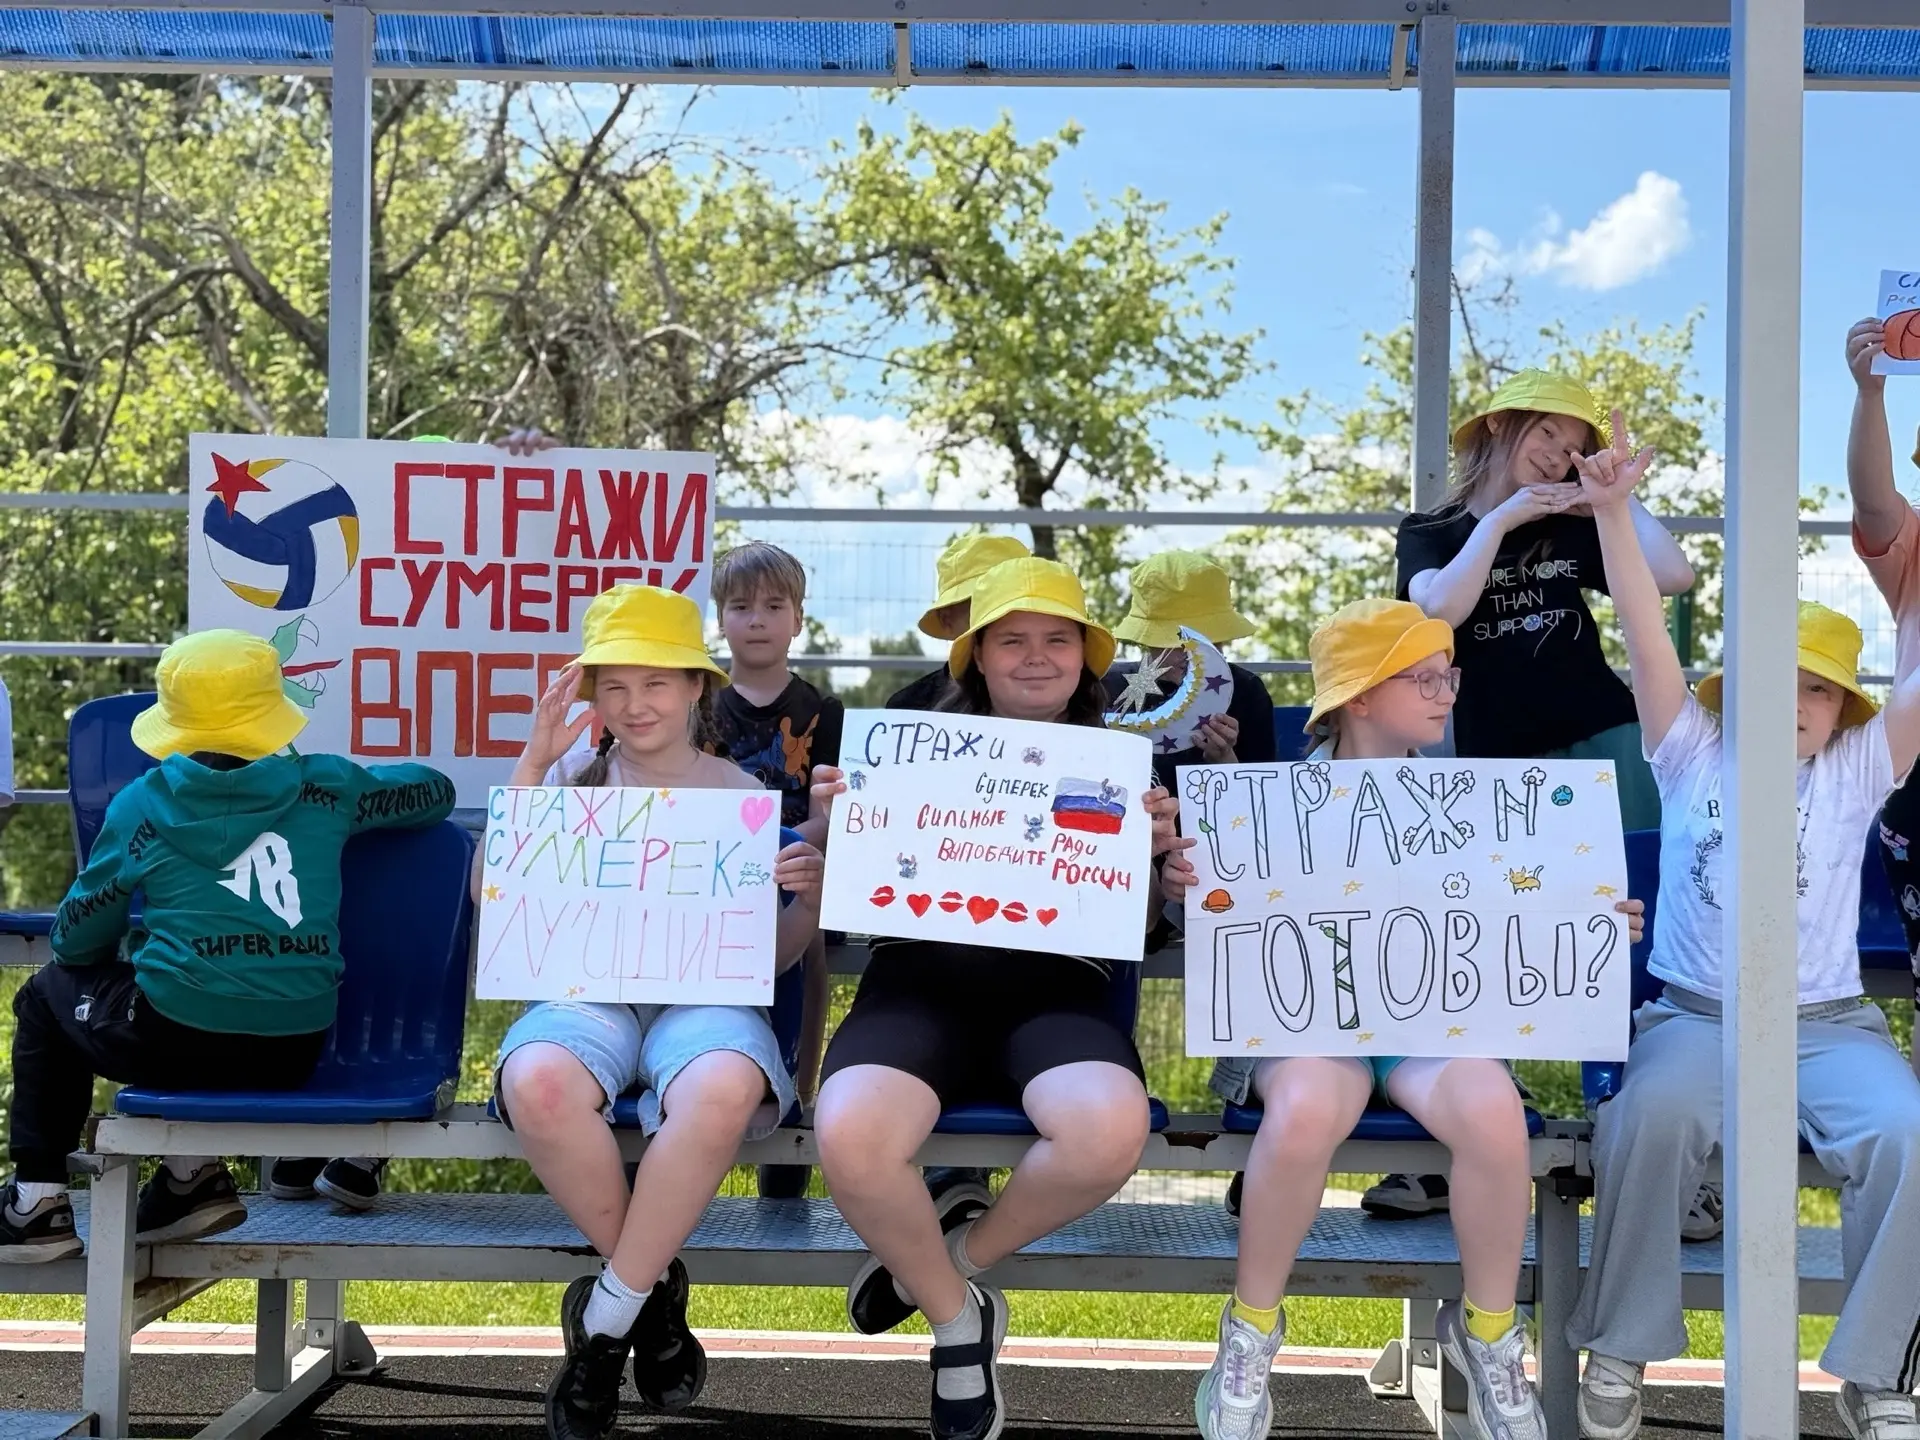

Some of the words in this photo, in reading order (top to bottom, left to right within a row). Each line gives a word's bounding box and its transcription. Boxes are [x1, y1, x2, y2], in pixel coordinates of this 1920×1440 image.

[393, 462, 708, 563] СТРАЖИ
[1522, 560, 1578, 583] MORE
[1474, 609, 1563, 641] SUPPORT
[1489, 588, 1543, 613] THAN
[489, 787, 654, 843] СТРАЖИ
[486, 830, 742, 898] СУМЕРЕК
[190, 933, 275, 960] SUPER
[482, 893, 755, 984] ЛУЧШИЕ
[1212, 906, 1618, 1042] ГОТОВЫ?
